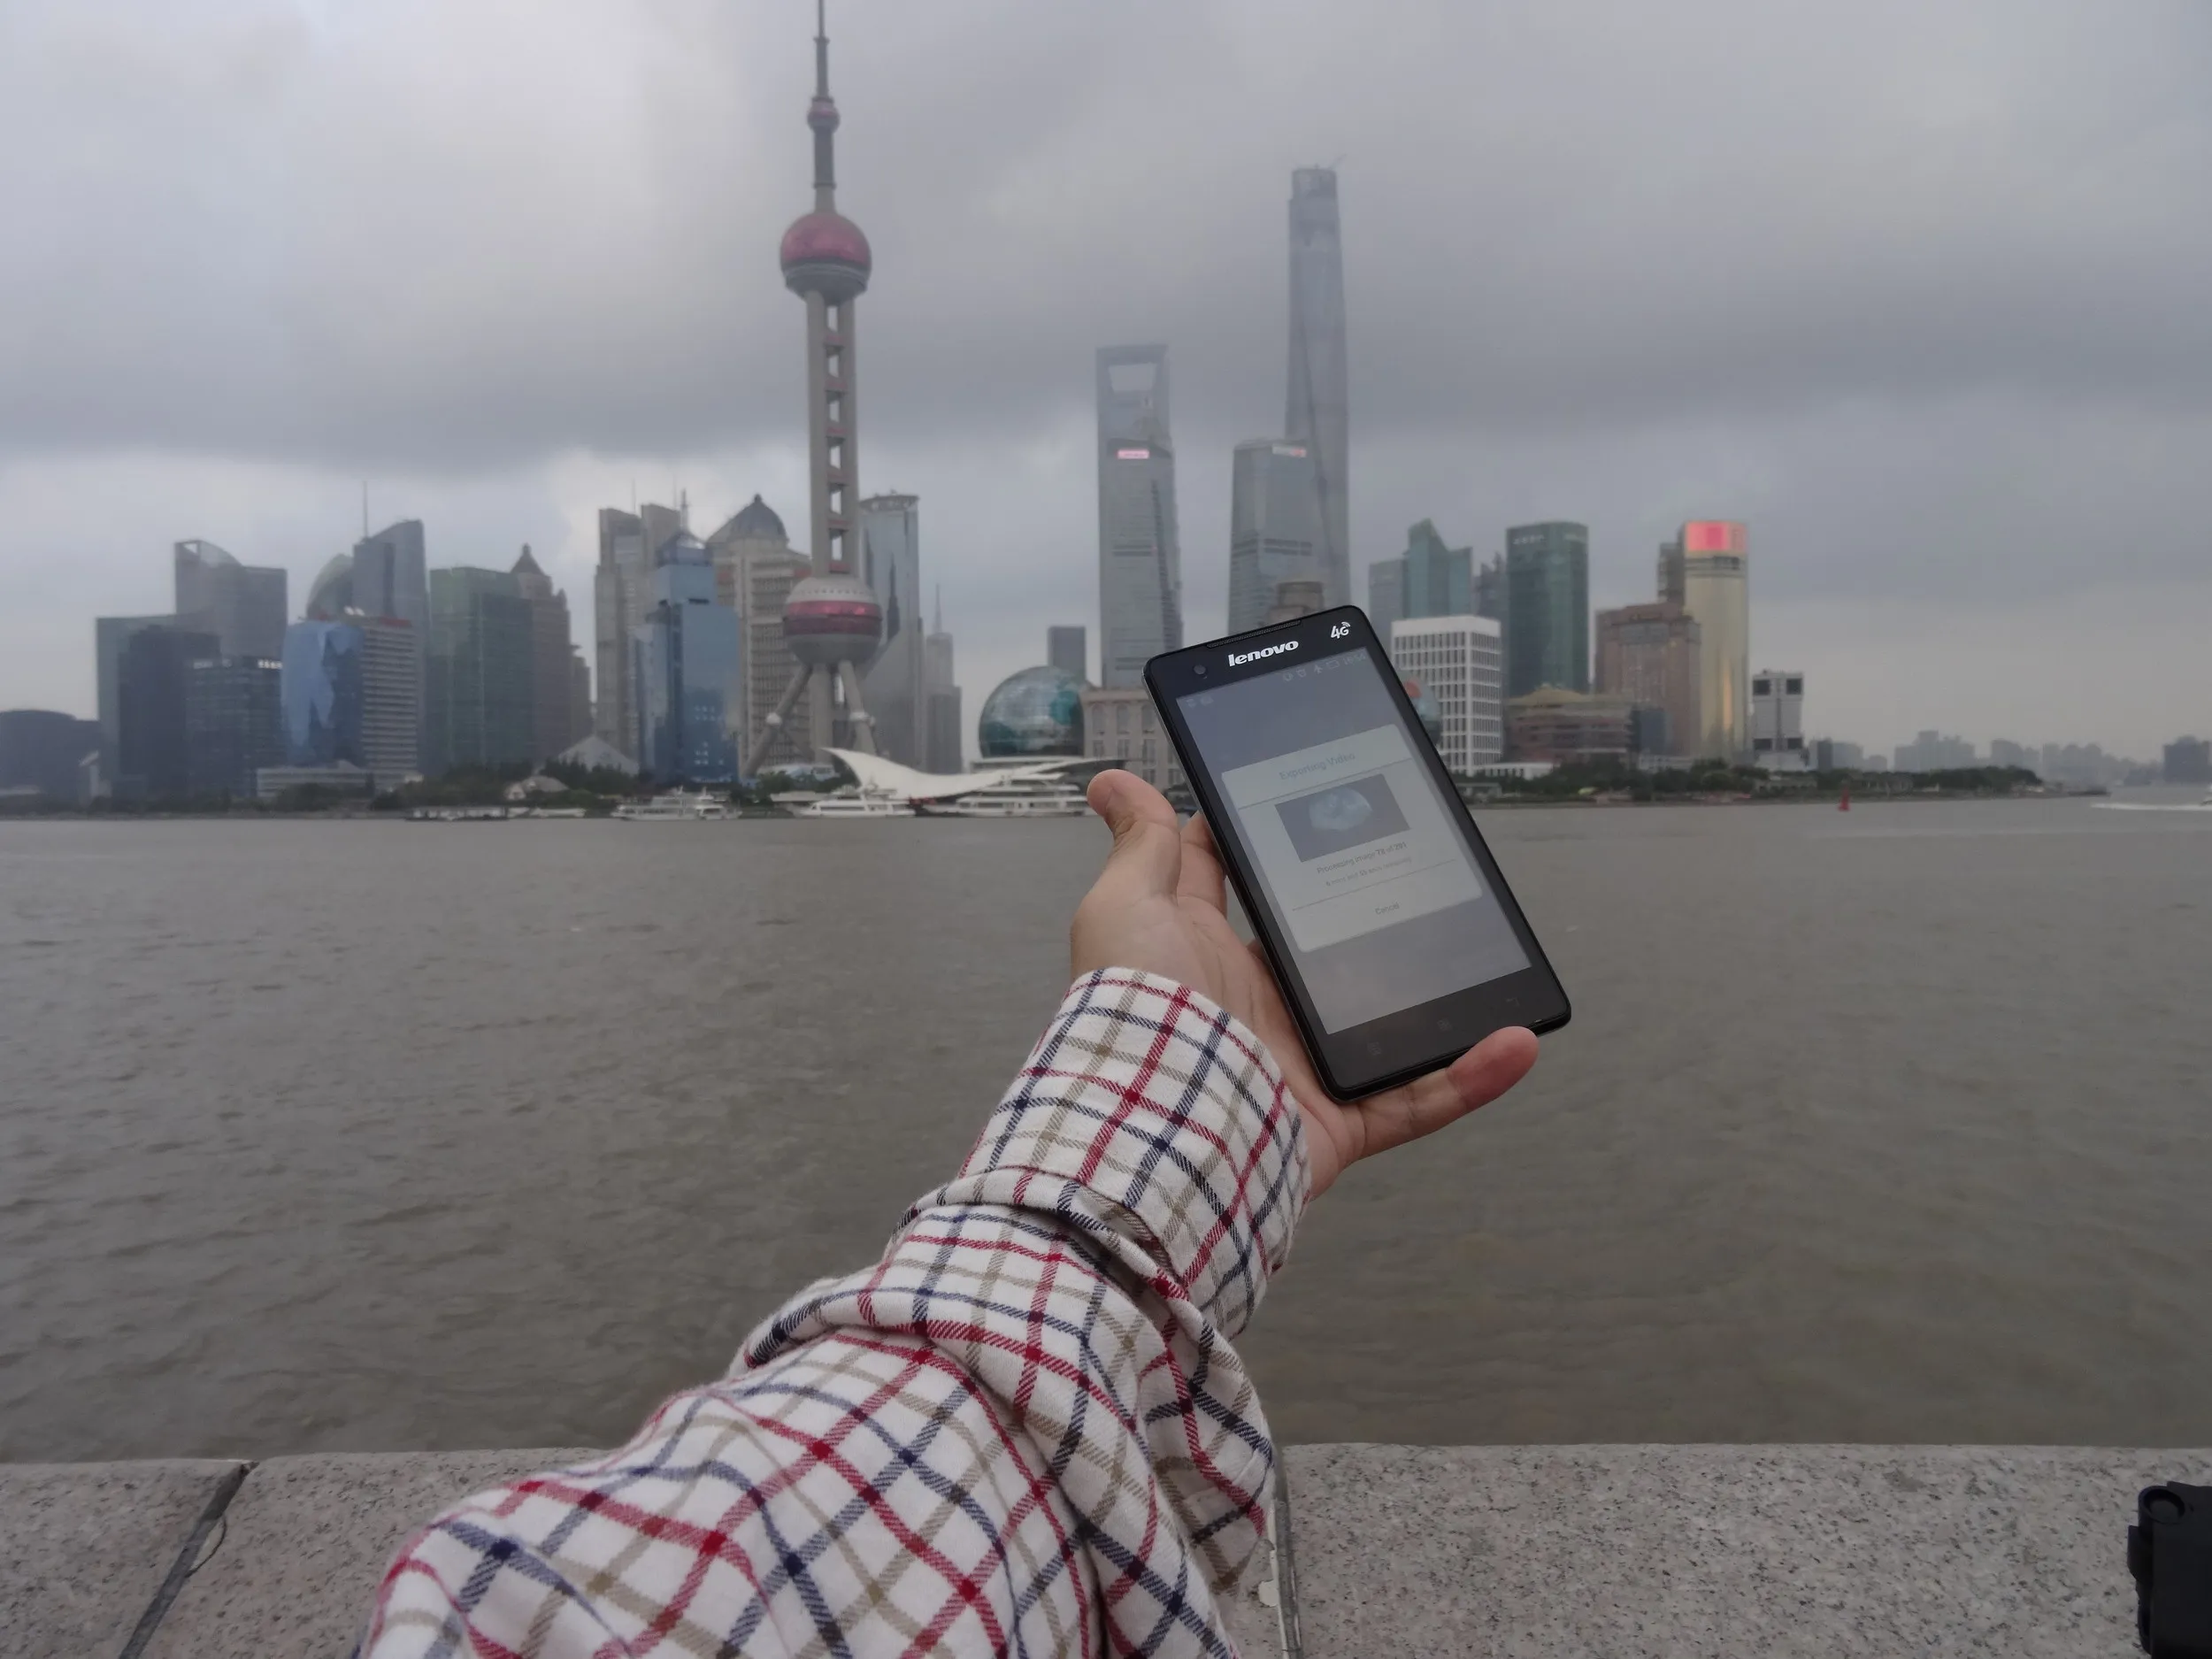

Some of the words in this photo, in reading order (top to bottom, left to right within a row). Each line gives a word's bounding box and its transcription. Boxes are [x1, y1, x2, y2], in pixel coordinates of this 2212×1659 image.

[1331, 625, 1350, 639] 4G
[1228, 641, 1299, 666] lenovo
[1279, 761, 1326, 780] Exporting
[1326, 752, 1355, 765] Video
